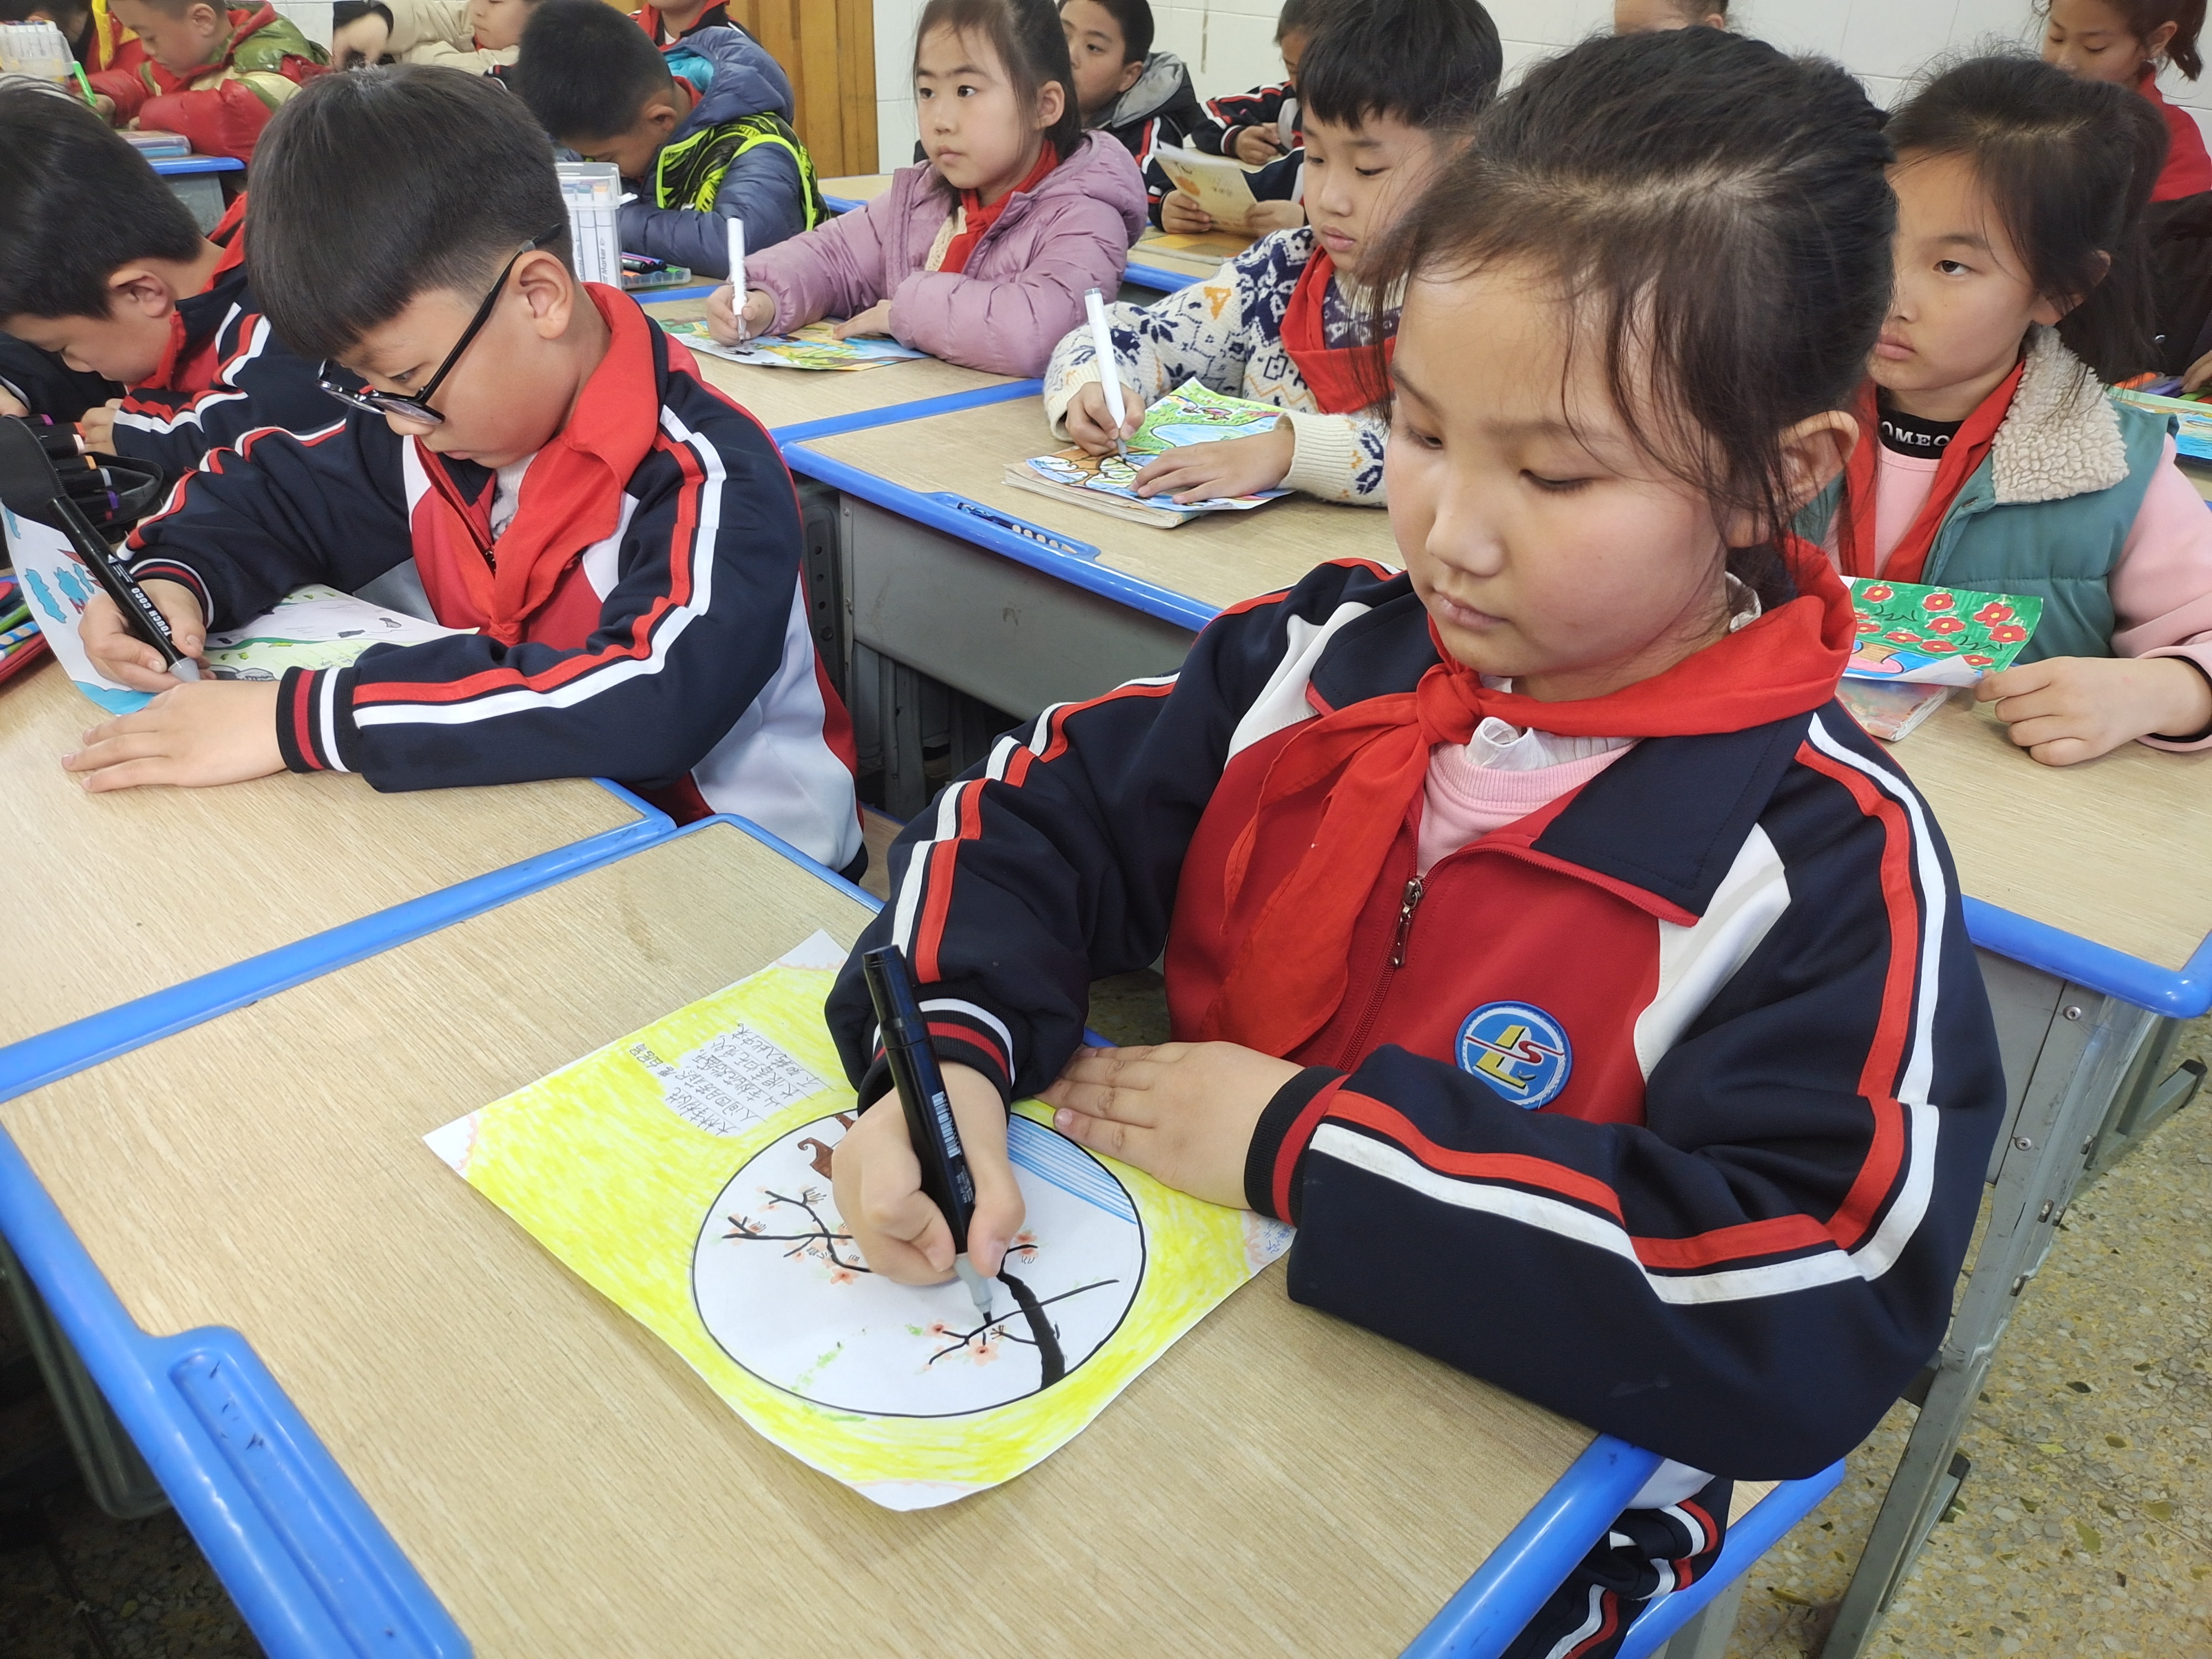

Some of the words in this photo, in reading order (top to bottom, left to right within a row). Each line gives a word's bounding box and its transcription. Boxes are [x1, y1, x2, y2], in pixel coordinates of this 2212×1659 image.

[131, 587, 152, 609] COCO
[149, 610, 172, 637] TOUCH
[666, 1087, 737, 1136] 大林寺桃花
